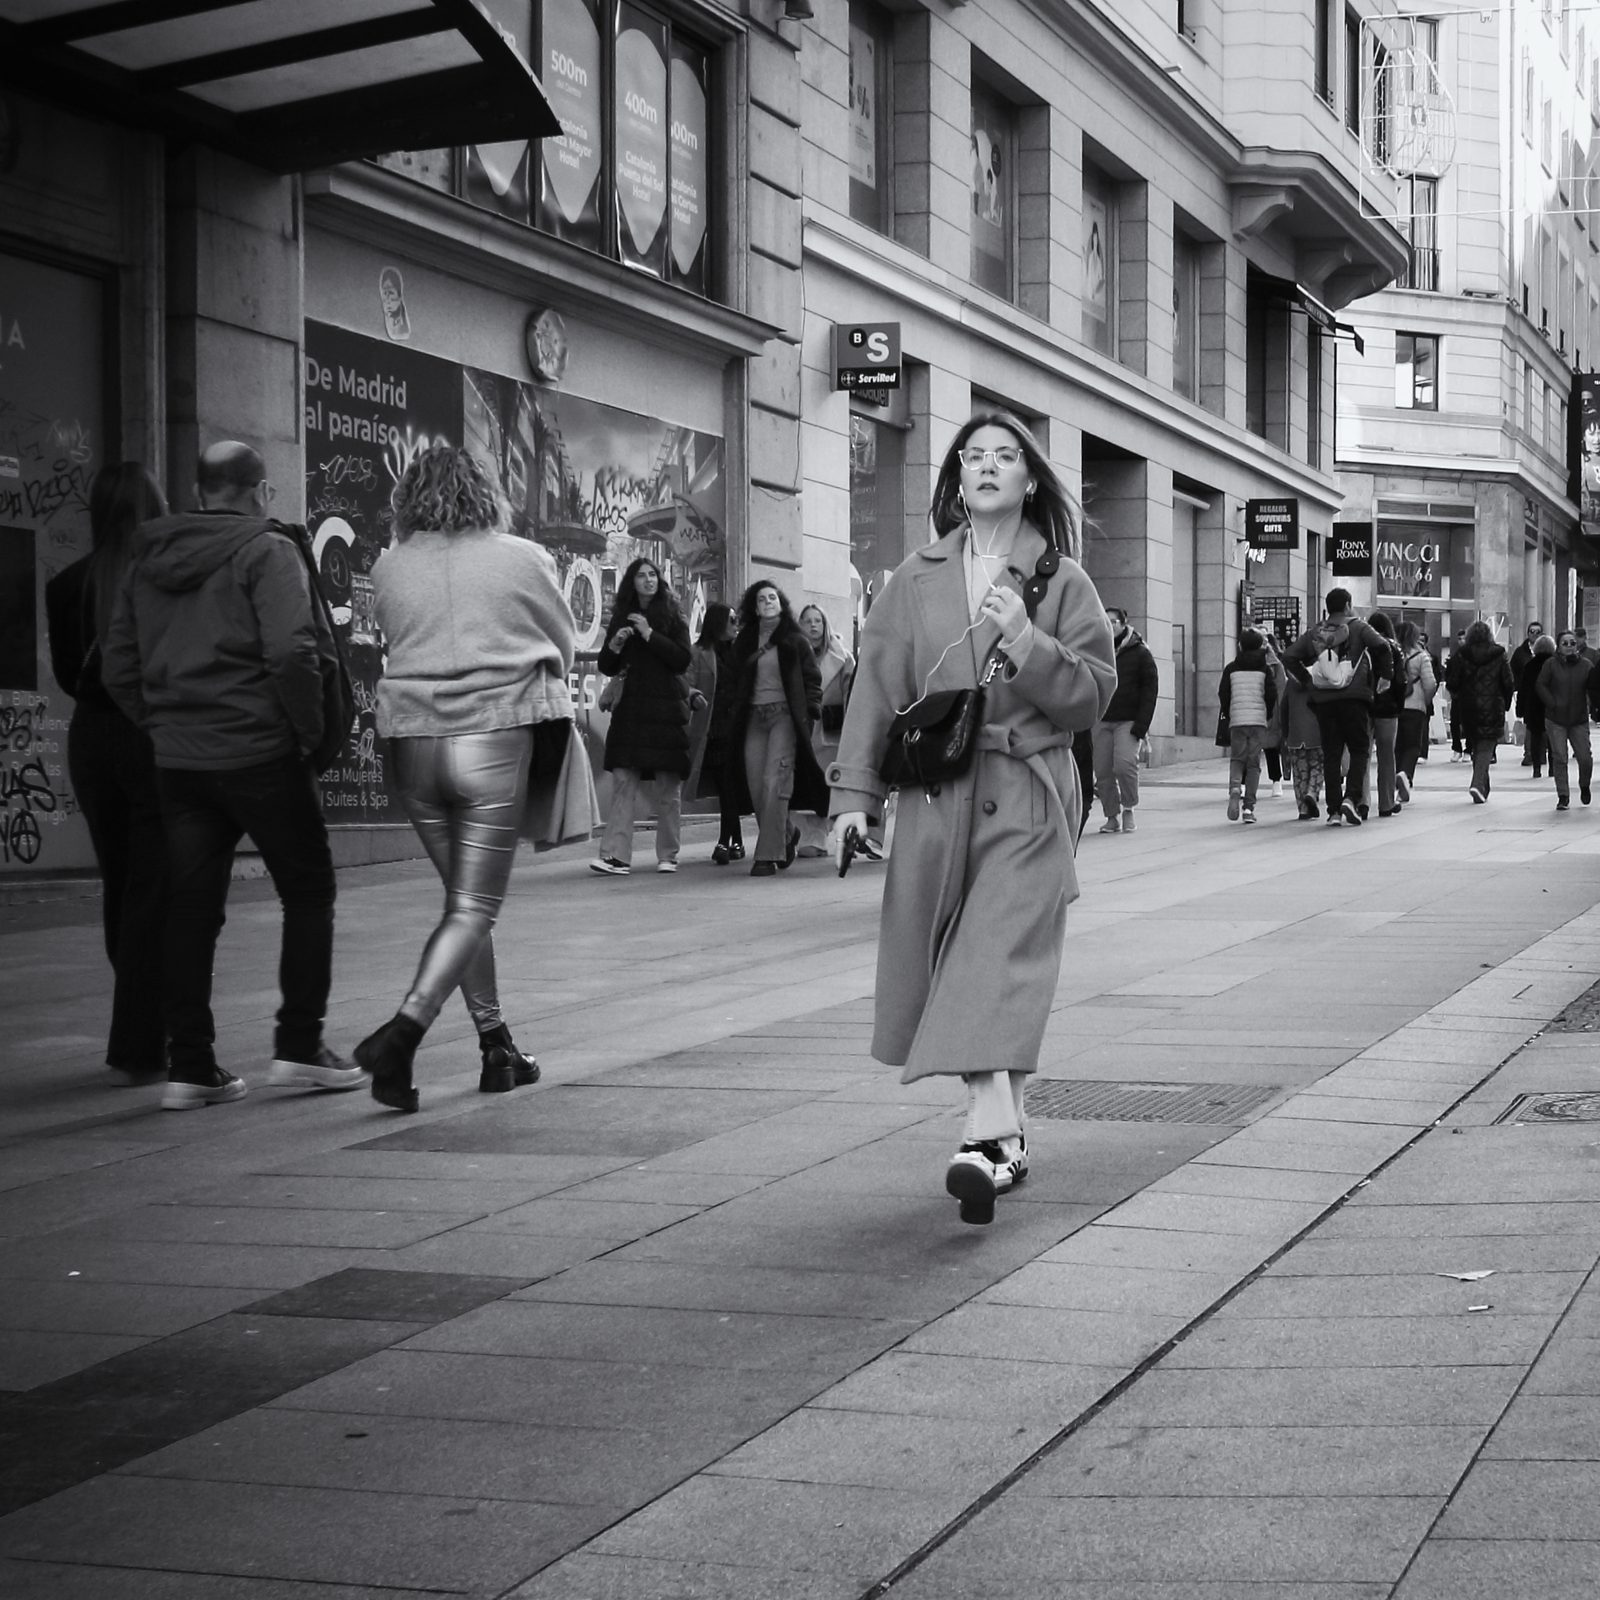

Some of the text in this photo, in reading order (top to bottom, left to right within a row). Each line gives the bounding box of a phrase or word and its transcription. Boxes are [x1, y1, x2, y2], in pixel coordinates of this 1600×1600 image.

[552, 50, 587, 87] 500m
[625, 91, 658, 124] 400m
[560, 149, 580, 169] Hotel
[625, 150, 657, 175] Catalonia
[632, 184, 651, 203] Hotel
[674, 207, 692, 226] Hotel
[853, 331, 890, 363] B S
[306, 356, 408, 410] De Madrid
[858, 372, 896, 384] ServiRed
[306, 400, 323, 432] al
[1255, 513, 1292, 523] SOUVENIRS
[1259, 504, 1288, 513] REGALOS
[1263, 524, 1283, 533] GIFTS
[1336, 548, 1370, 560] ROMA'S
[1339, 539, 1366, 550] TONY
[1379, 564, 1433, 582] VIA 66
[342, 767, 384, 787] Mujeres
[326, 791, 358, 807] Suites
[360, 791, 368, 807] &
[369, 791, 389, 810] Spa
